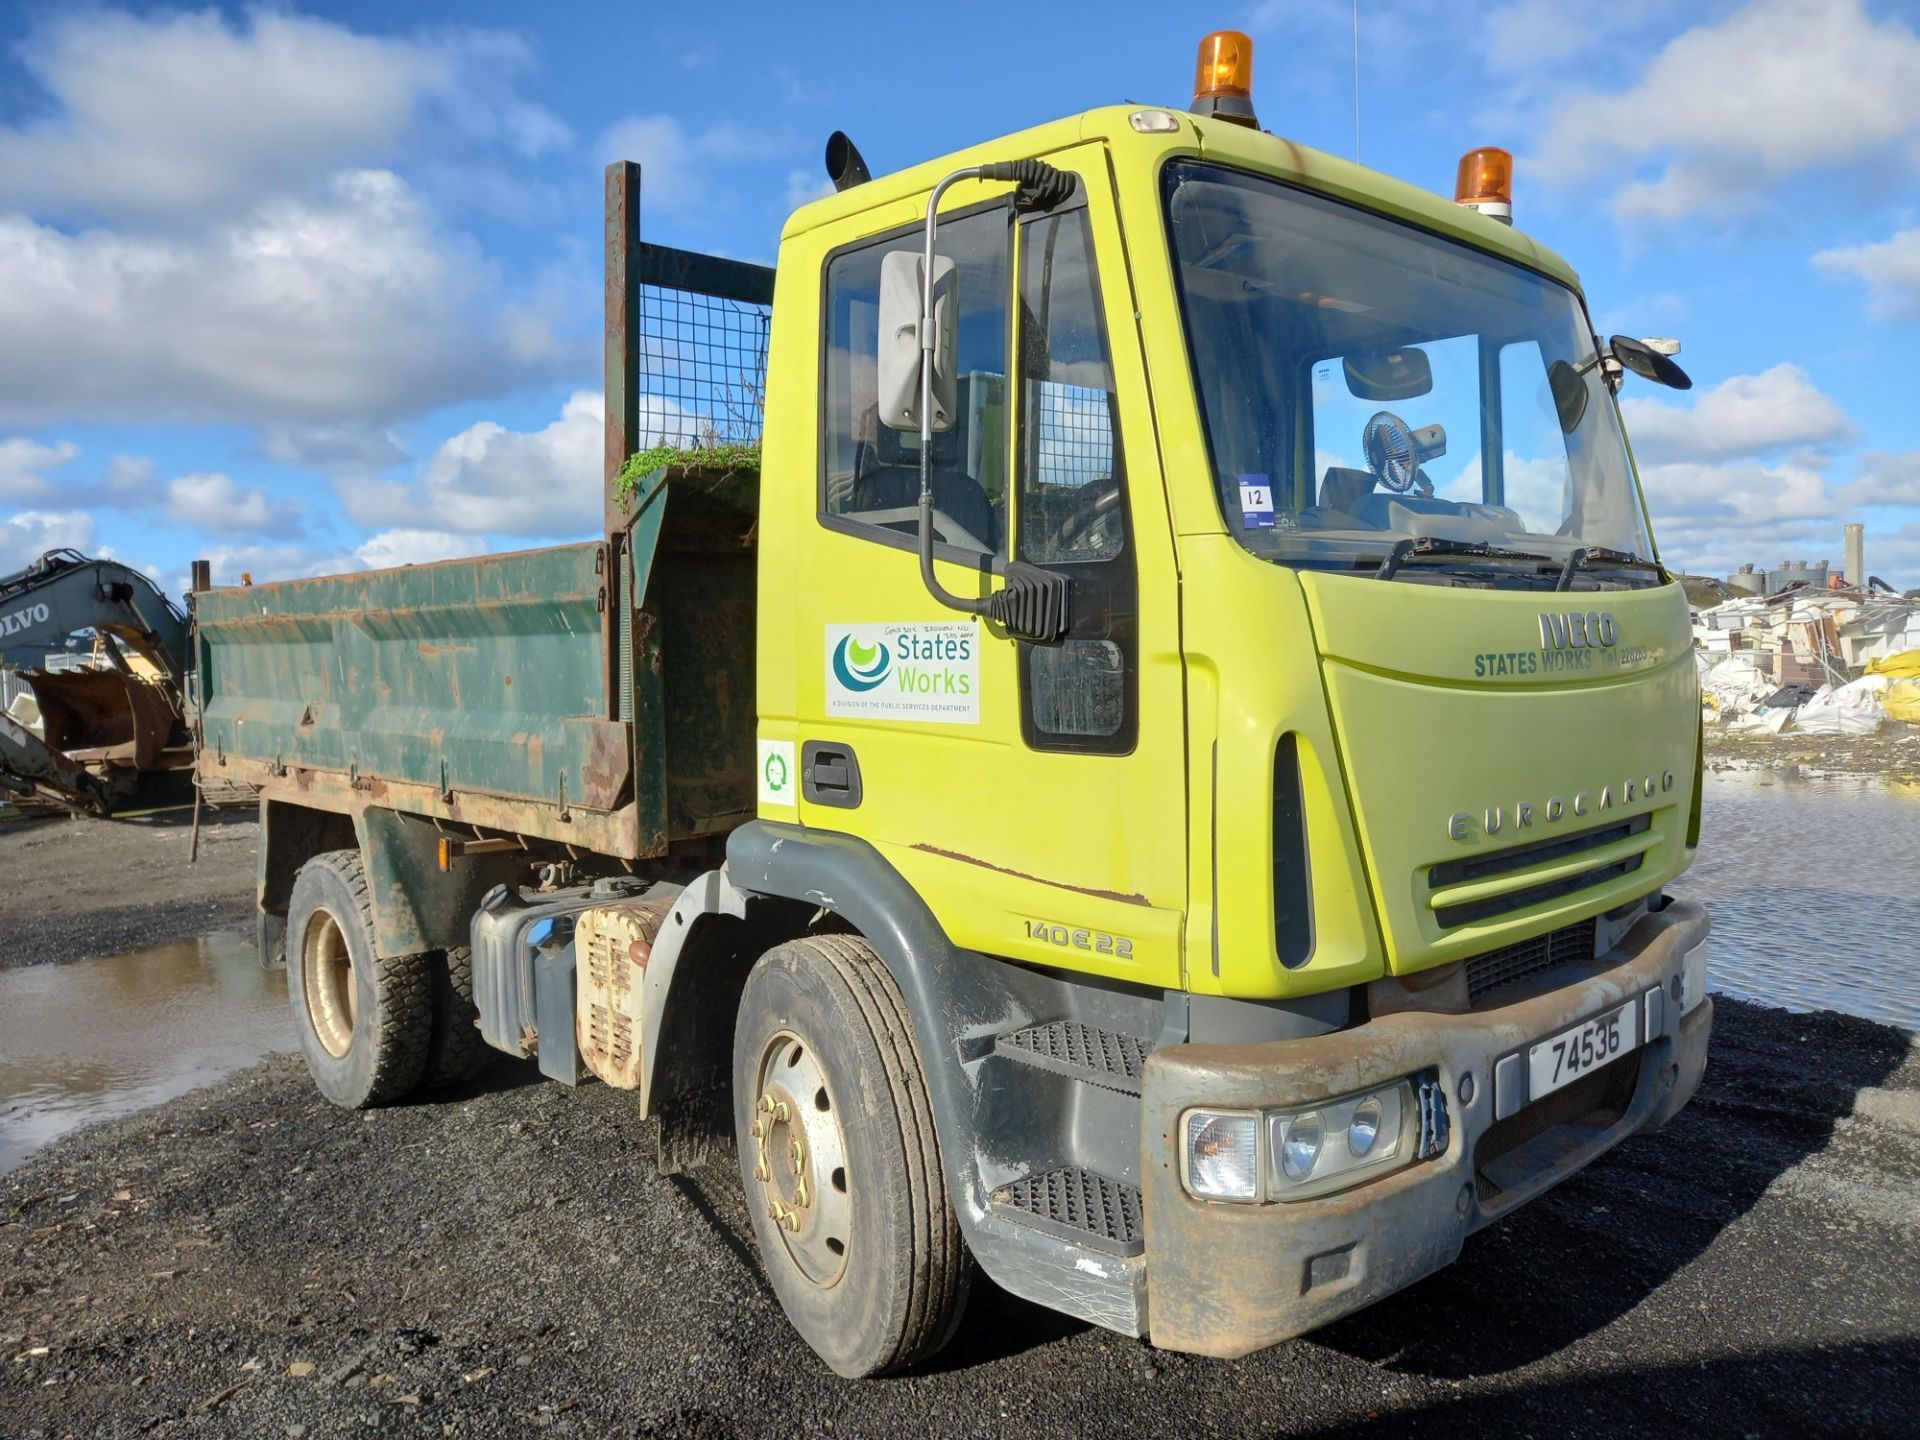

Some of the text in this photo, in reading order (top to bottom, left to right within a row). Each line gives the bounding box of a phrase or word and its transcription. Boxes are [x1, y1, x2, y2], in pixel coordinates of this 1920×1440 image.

[1248, 489, 1263, 505] 12
[0, 603, 49, 638] LVO
[1537, 611, 1618, 650] IVECO
[897, 634, 970, 660] States
[1475, 652, 1537, 677] STATES
[1541, 650, 1593, 672] WORKS
[898, 667, 970, 695] Works
[902, 703, 929, 711] SERVICES
[931, 704, 970, 712] DEPARTMENT
[1448, 769, 1674, 840] EUROCARGO
[1552, 1017, 1620, 1084] 74536
